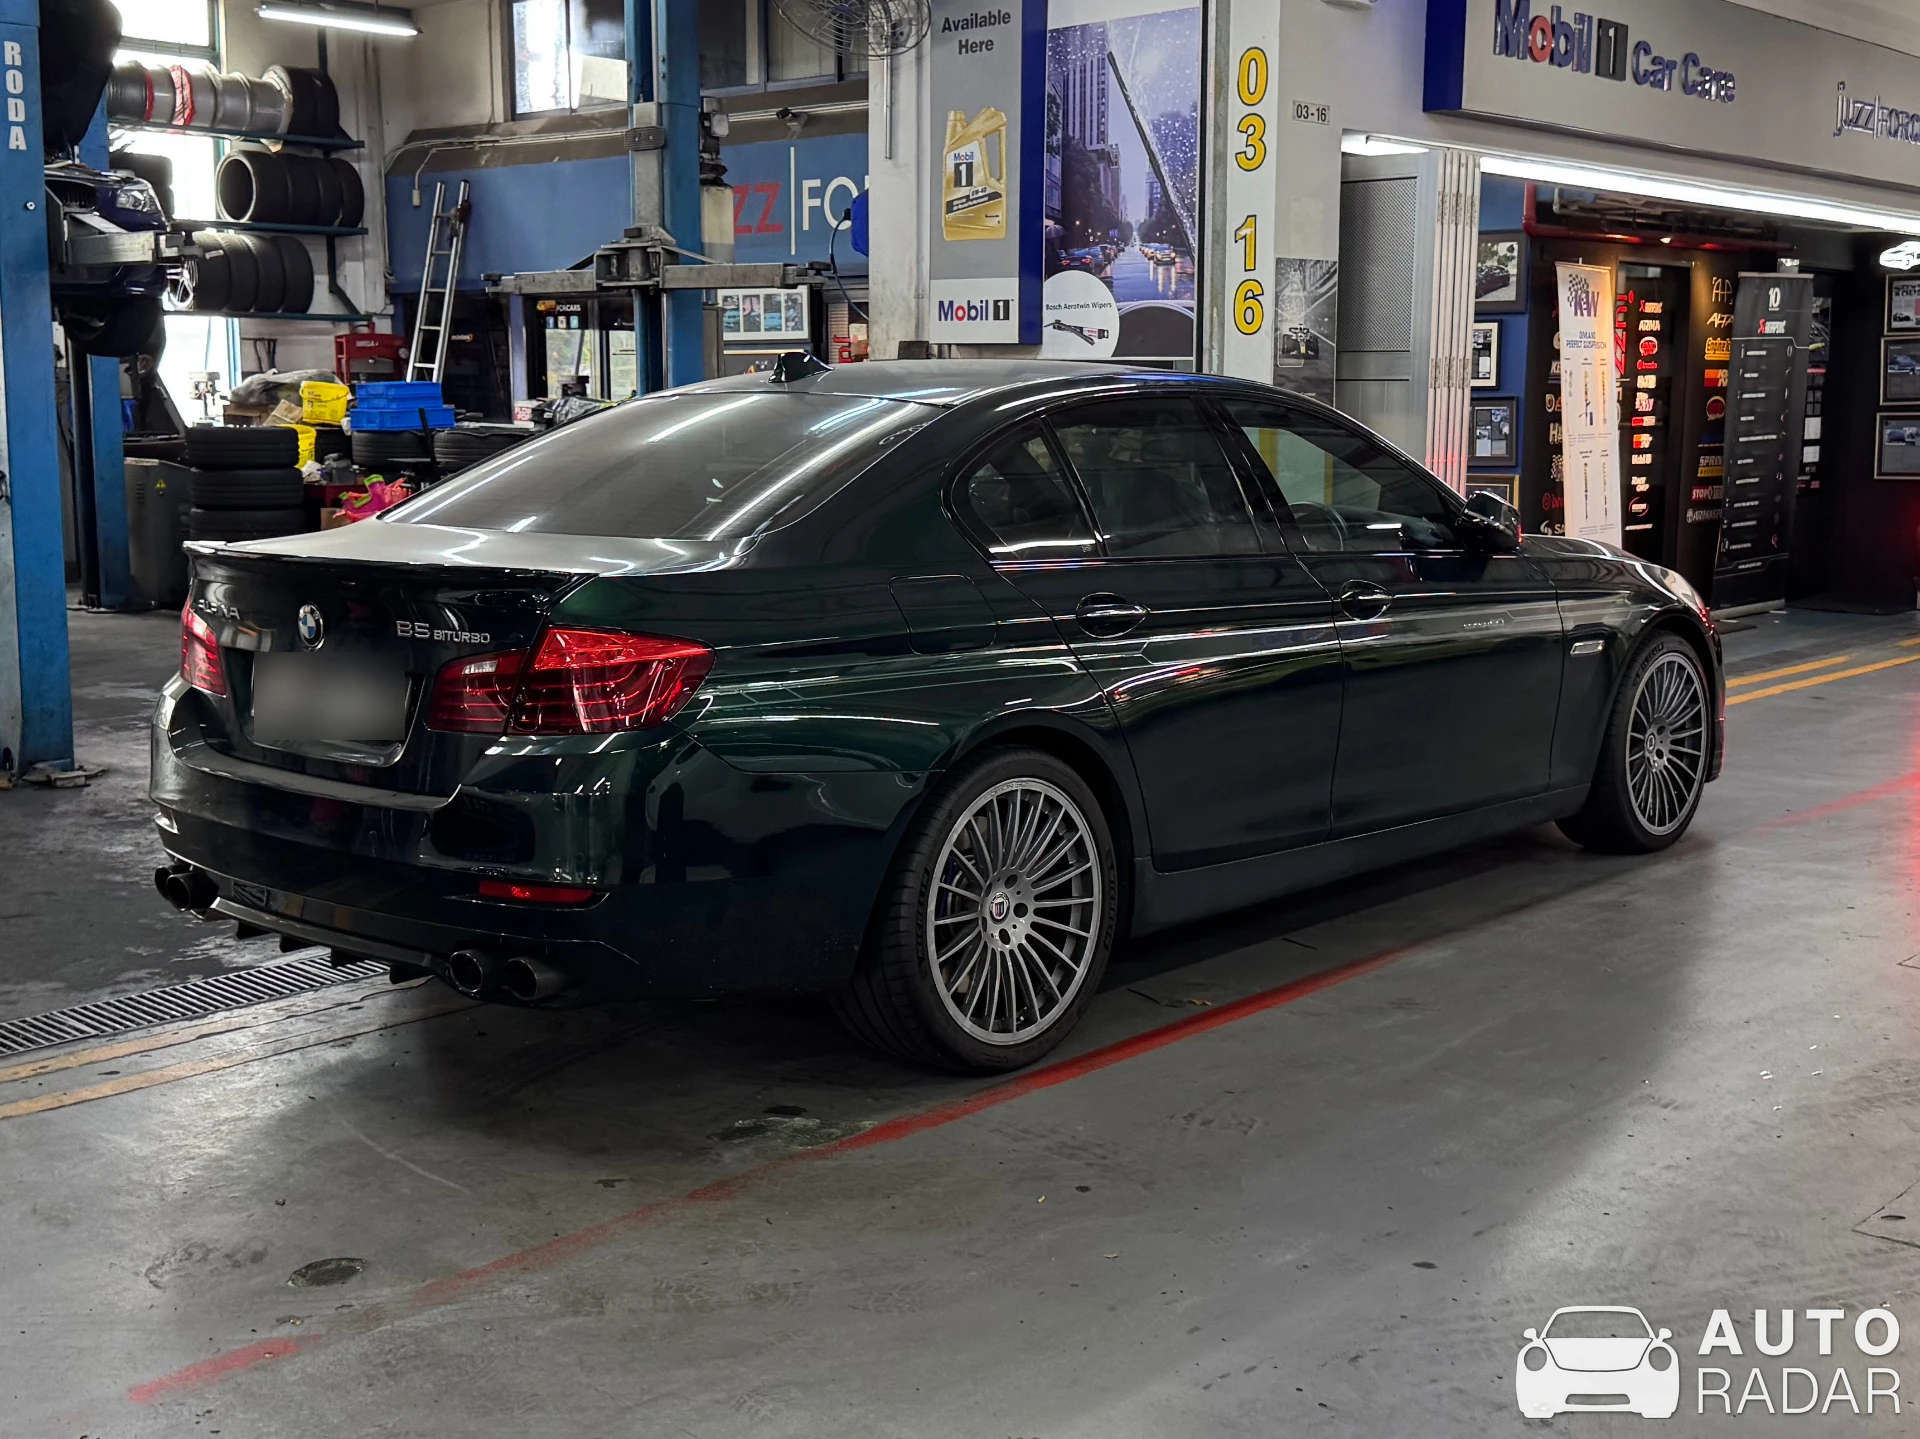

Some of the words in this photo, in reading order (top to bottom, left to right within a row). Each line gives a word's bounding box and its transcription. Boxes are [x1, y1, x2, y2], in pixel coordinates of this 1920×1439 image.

[941, 9, 1011, 33] Available
[958, 39, 994, 55] Here
[1493, 0, 1593, 73] Mobil
[1632, 40, 1677, 92] Car
[1682, 52, 1736, 103] Care
[4, 40, 27, 150] RODA
[1296, 103, 1327, 123] 03-16
[954, 152, 974, 161] Mobil
[802, 175, 869, 231] FO
[1046, 303, 1062, 311] Bosch
[1064, 302, 1090, 310] Aerotwin
[1091, 301, 1112, 310] Wipers
[1768, 287, 1780, 308] 10
[938, 300, 988, 321] Mobil
[396, 620, 430, 638] B5
[433, 628, 490, 644] BITURBO
